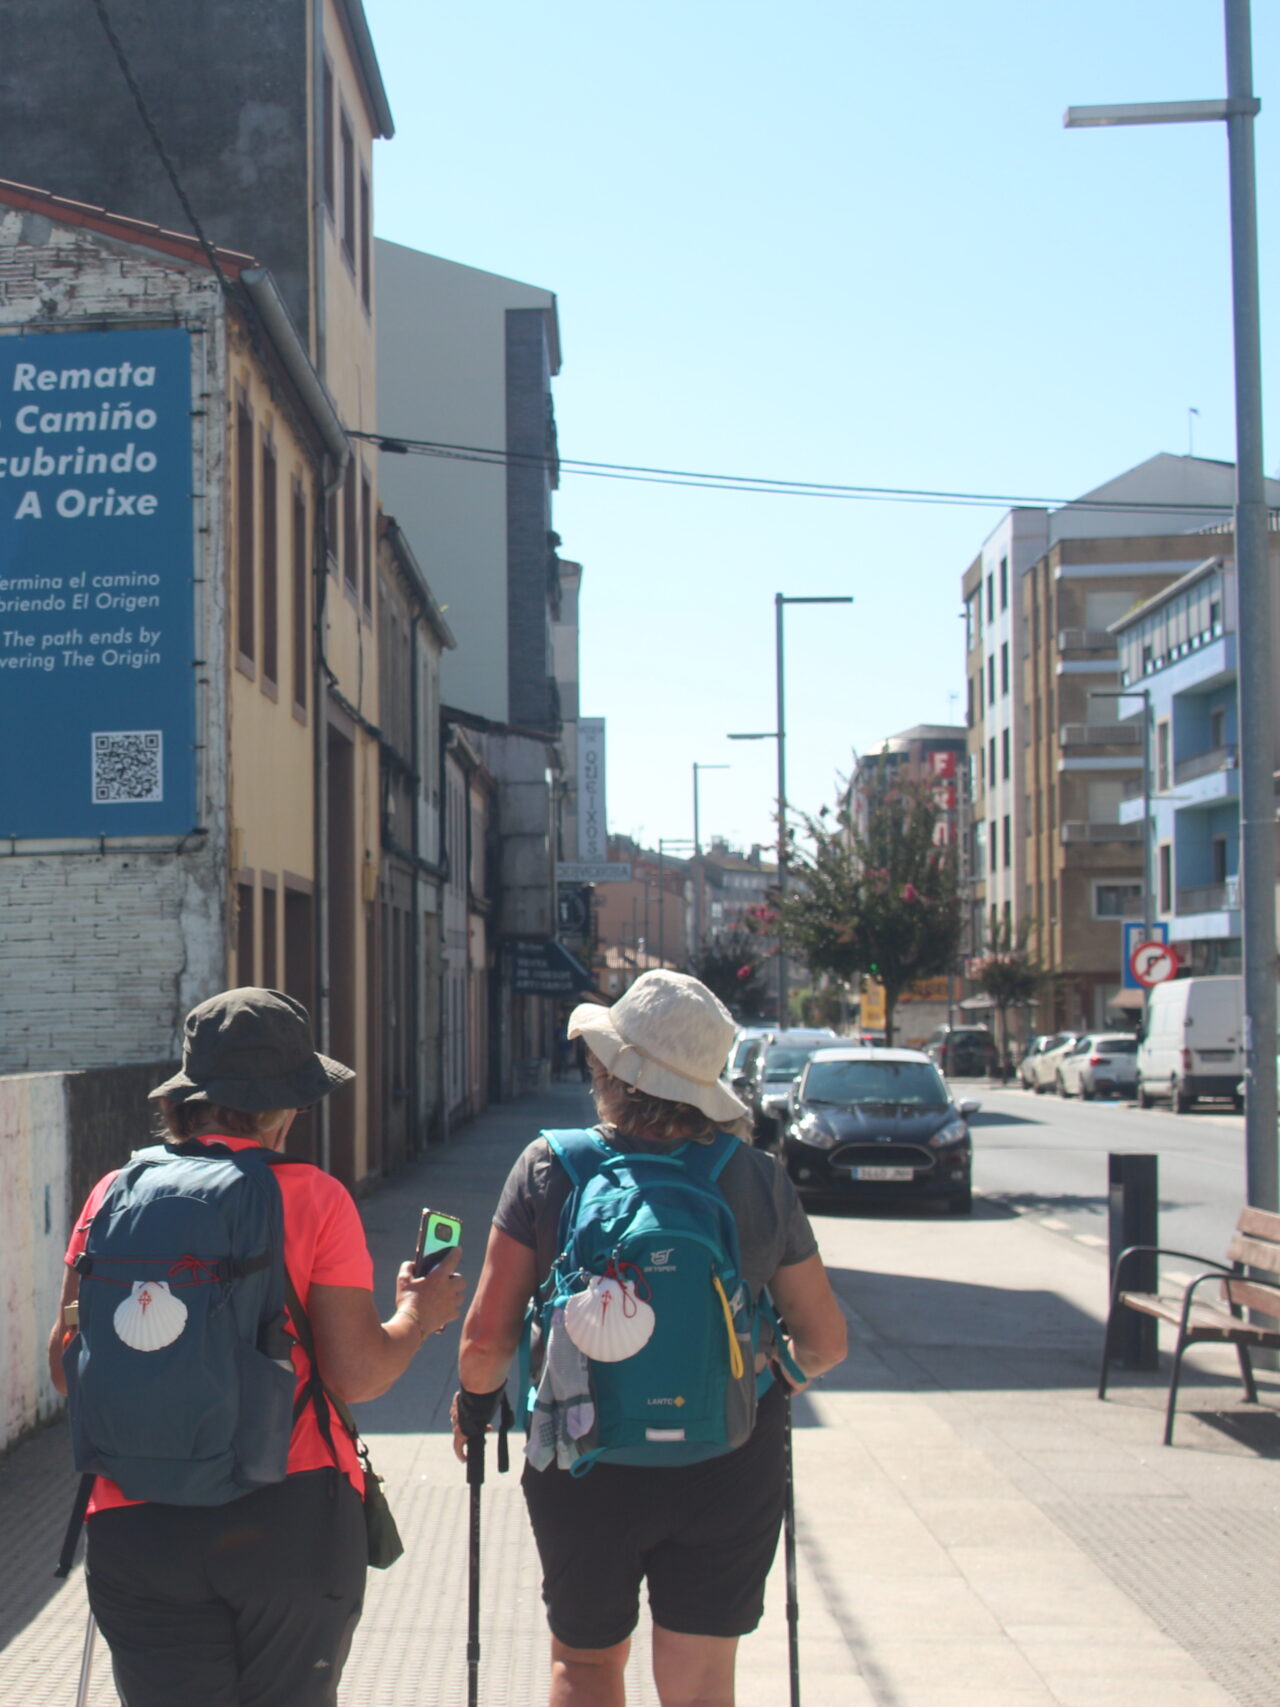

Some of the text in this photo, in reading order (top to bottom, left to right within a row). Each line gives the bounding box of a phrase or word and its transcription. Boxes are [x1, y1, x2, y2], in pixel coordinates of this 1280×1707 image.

[13, 362, 156, 392] Remata
[15, 402, 157, 434] Camiño
[14, 487, 158, 519] A Orixe
[69, 571, 86, 588] el
[92, 571, 160, 588] camino
[72, 593, 88, 610] El
[95, 592, 160, 612] Origen
[3, 626, 161, 649] The path ends by
[62, 651, 95, 667] The
[101, 649, 161, 669] Origin
